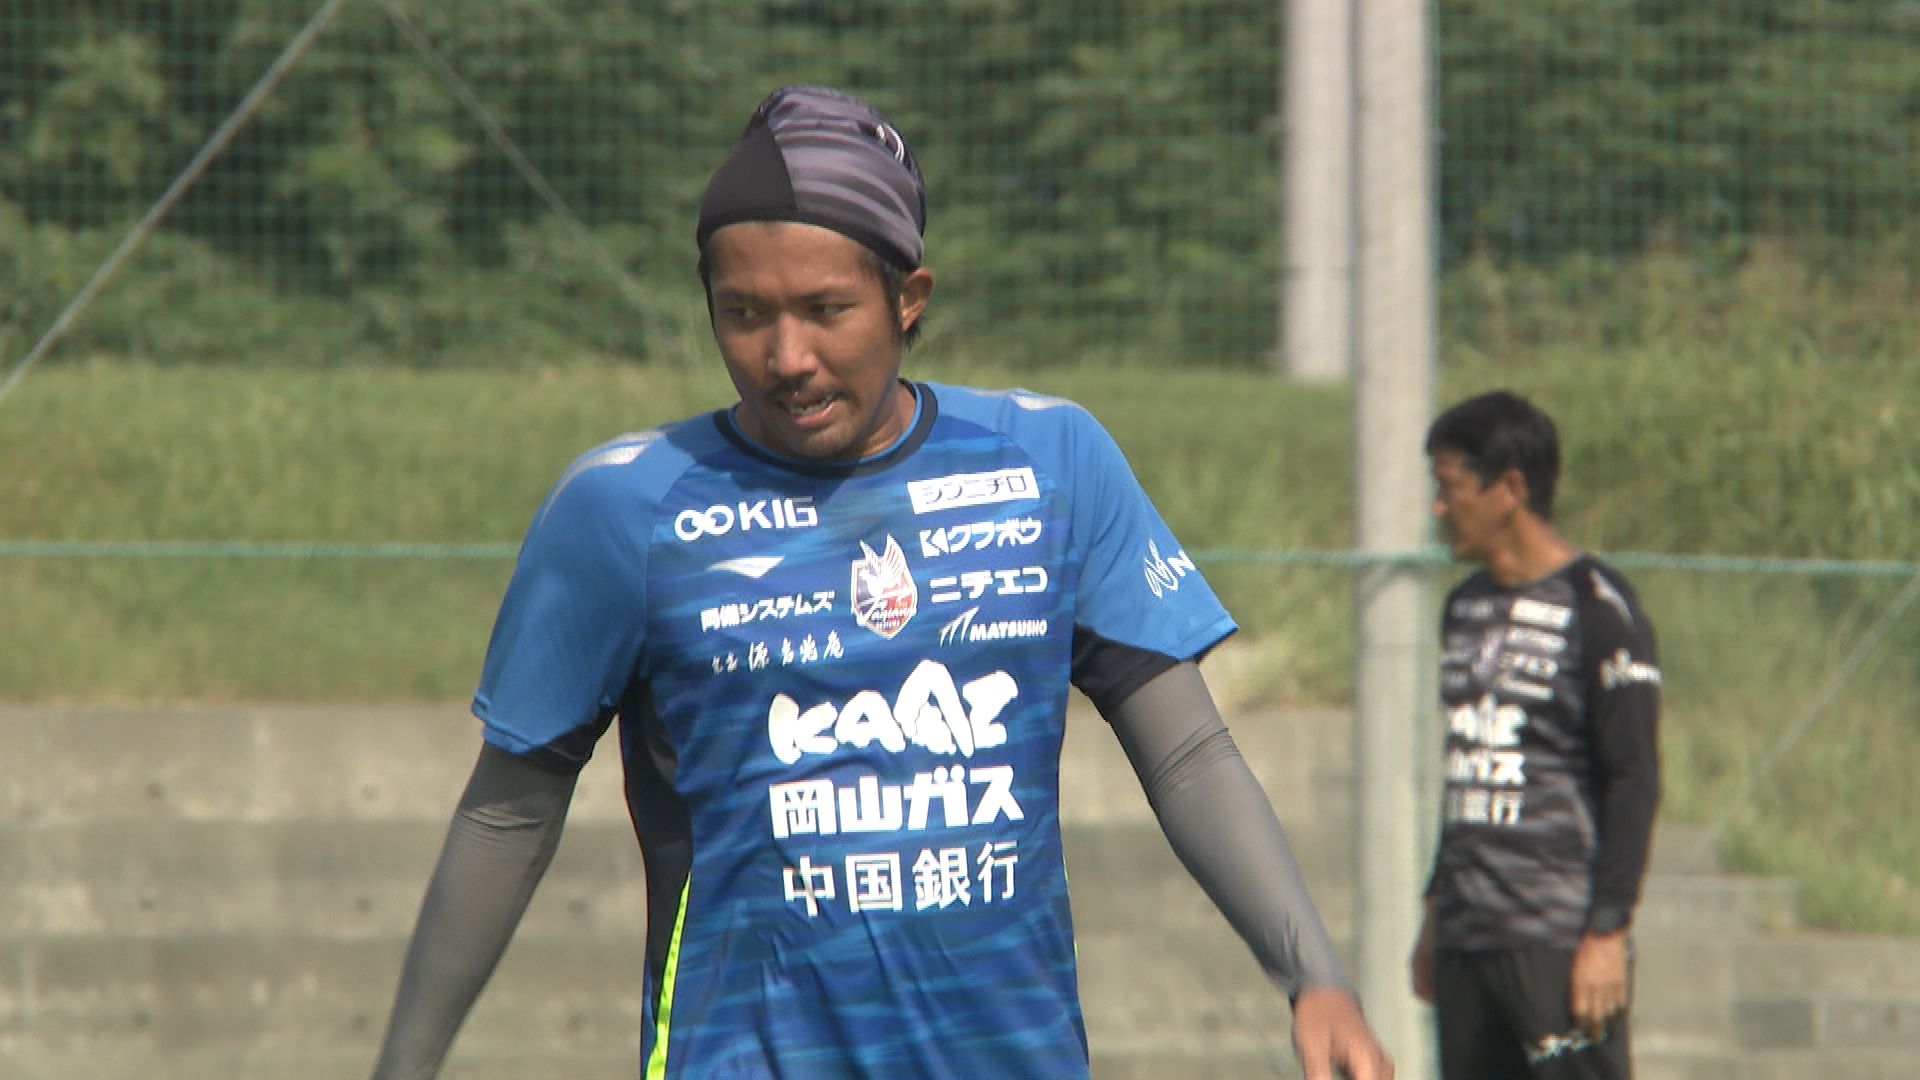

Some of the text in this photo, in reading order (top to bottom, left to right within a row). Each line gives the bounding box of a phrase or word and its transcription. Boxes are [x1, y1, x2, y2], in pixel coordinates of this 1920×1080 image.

[930, 565, 1048, 603] ニチエコ
[769, 764, 1025, 839] 岡山ガス
[783, 840, 1018, 917] 中国銀行
